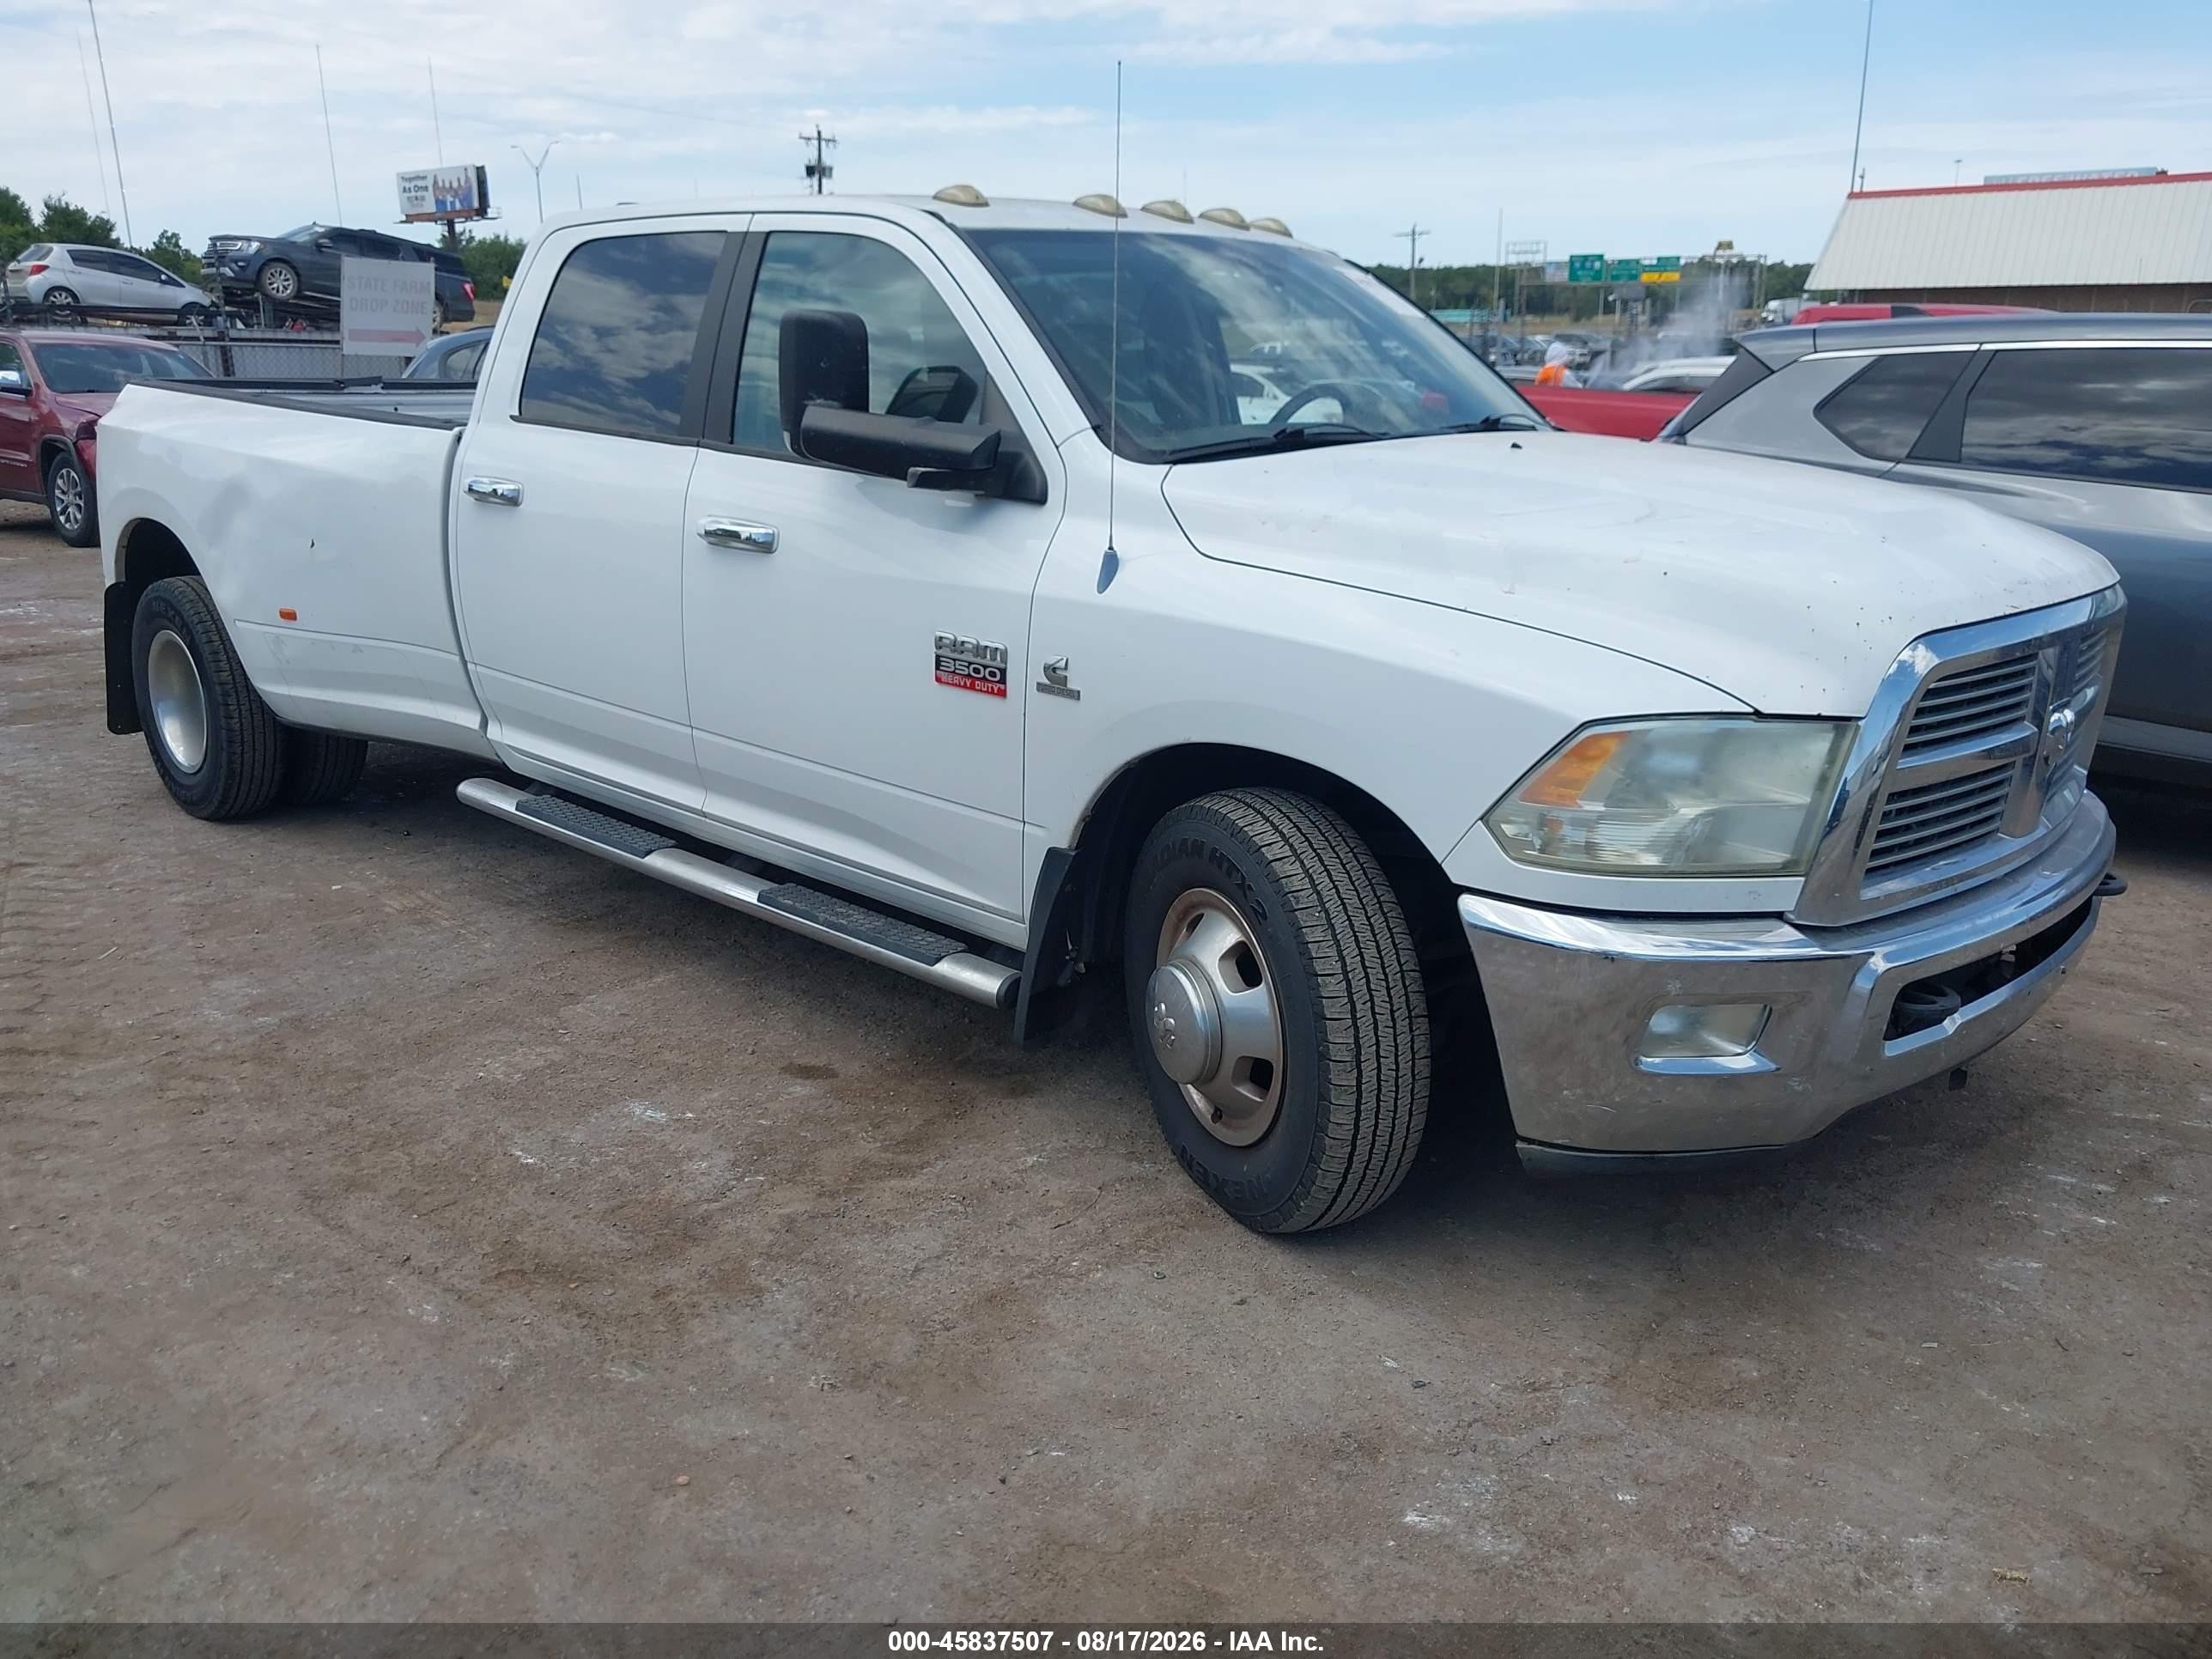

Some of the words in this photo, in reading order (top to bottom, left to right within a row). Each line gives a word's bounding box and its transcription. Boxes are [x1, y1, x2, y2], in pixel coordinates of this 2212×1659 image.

[413, 185, 428, 193] One
[347, 276, 388, 293] STATE
[392, 279, 431, 295] FARM
[349, 297, 388, 313] DROP
[392, 299, 427, 316] ZONE
[934, 630, 1008, 665] RAM
[939, 658, 1001, 681] 3500
[940, 673, 973, 688] HEAVY
[975, 681, 1000, 694] DUTY
